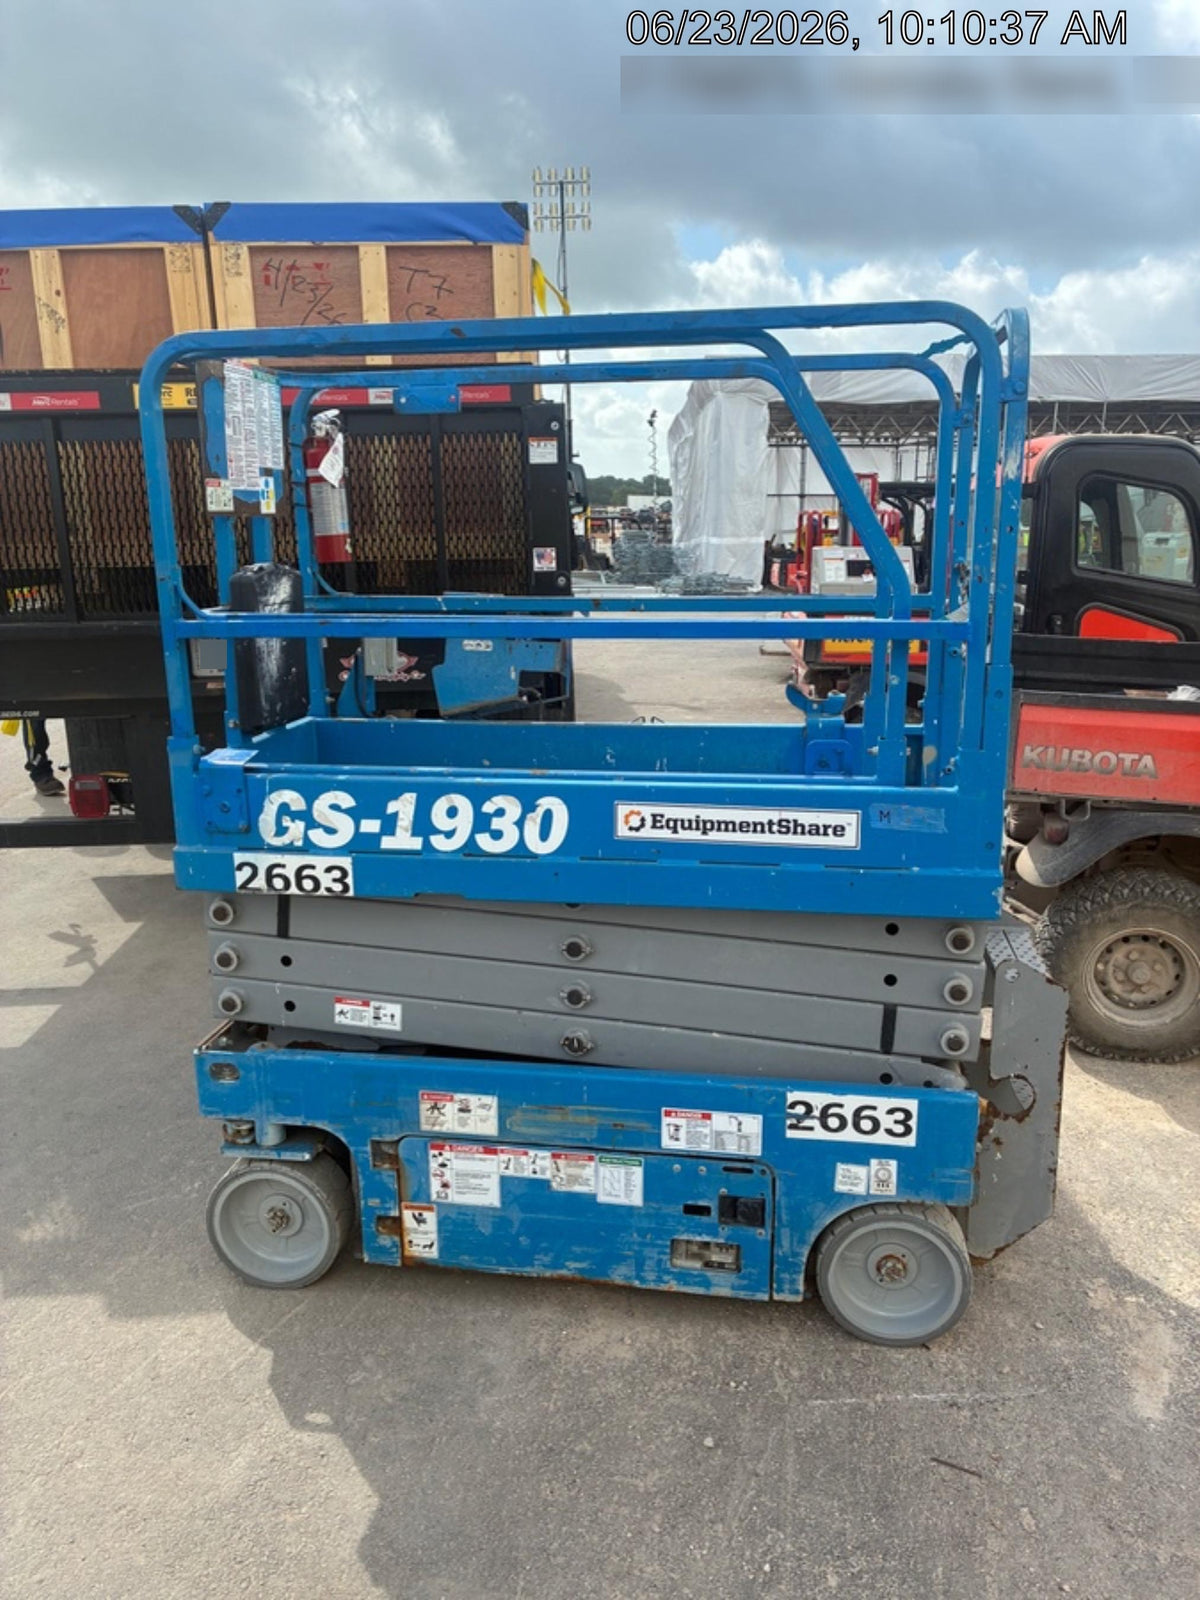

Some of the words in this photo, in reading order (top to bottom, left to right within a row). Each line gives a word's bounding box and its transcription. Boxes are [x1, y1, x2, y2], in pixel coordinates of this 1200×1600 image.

[1021, 744, 1158, 779] KUBOTA
[258, 789, 569, 855] GS-1930
[650, 812, 846, 838] EquipmentShare
[235, 861, 351, 896] 2663
[787, 1100, 914, 1138] 2663
